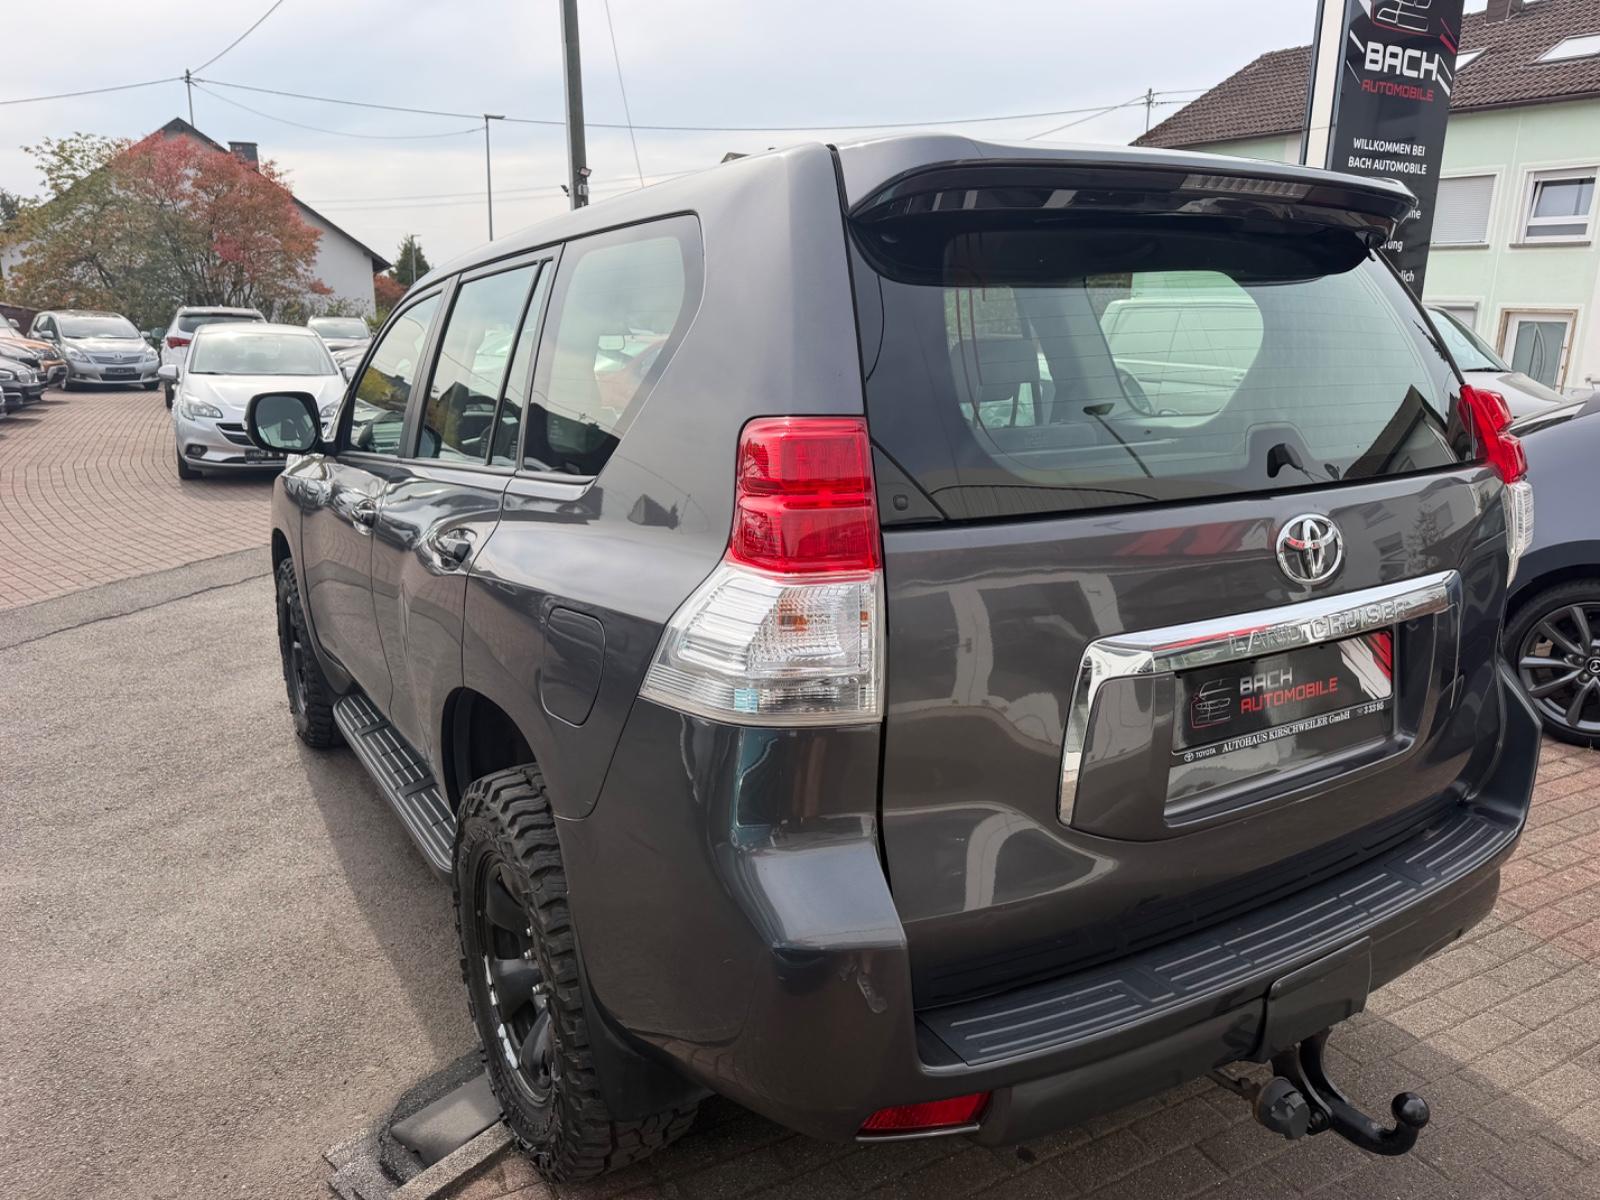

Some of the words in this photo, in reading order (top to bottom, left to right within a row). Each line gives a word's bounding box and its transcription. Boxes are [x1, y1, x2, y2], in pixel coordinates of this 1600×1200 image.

[1364, 41, 1439, 81] BACH
[1361, 79, 1434, 102] AUTOMOBILE
[1353, 137, 1411, 155] WILLKOMMEN
[1412, 144, 1425, 156] BEI
[1348, 156, 1372, 169] BACH
[1373, 159, 1427, 175] AUTOMOBILE
[1228, 623, 1301, 654] LAND
[1310, 600, 1410, 640] CRUISER
[1239, 667, 1293, 695] BACH
[1240, 676, 1338, 714] AUTOMOBILE
[1195, 747, 1216, 758] TOYOTA
[1222, 732, 1268, 753] AUTOHAUS
[1269, 716, 1328, 740] KIRSCHWEILER
[1329, 710, 1350, 725] GmbH
